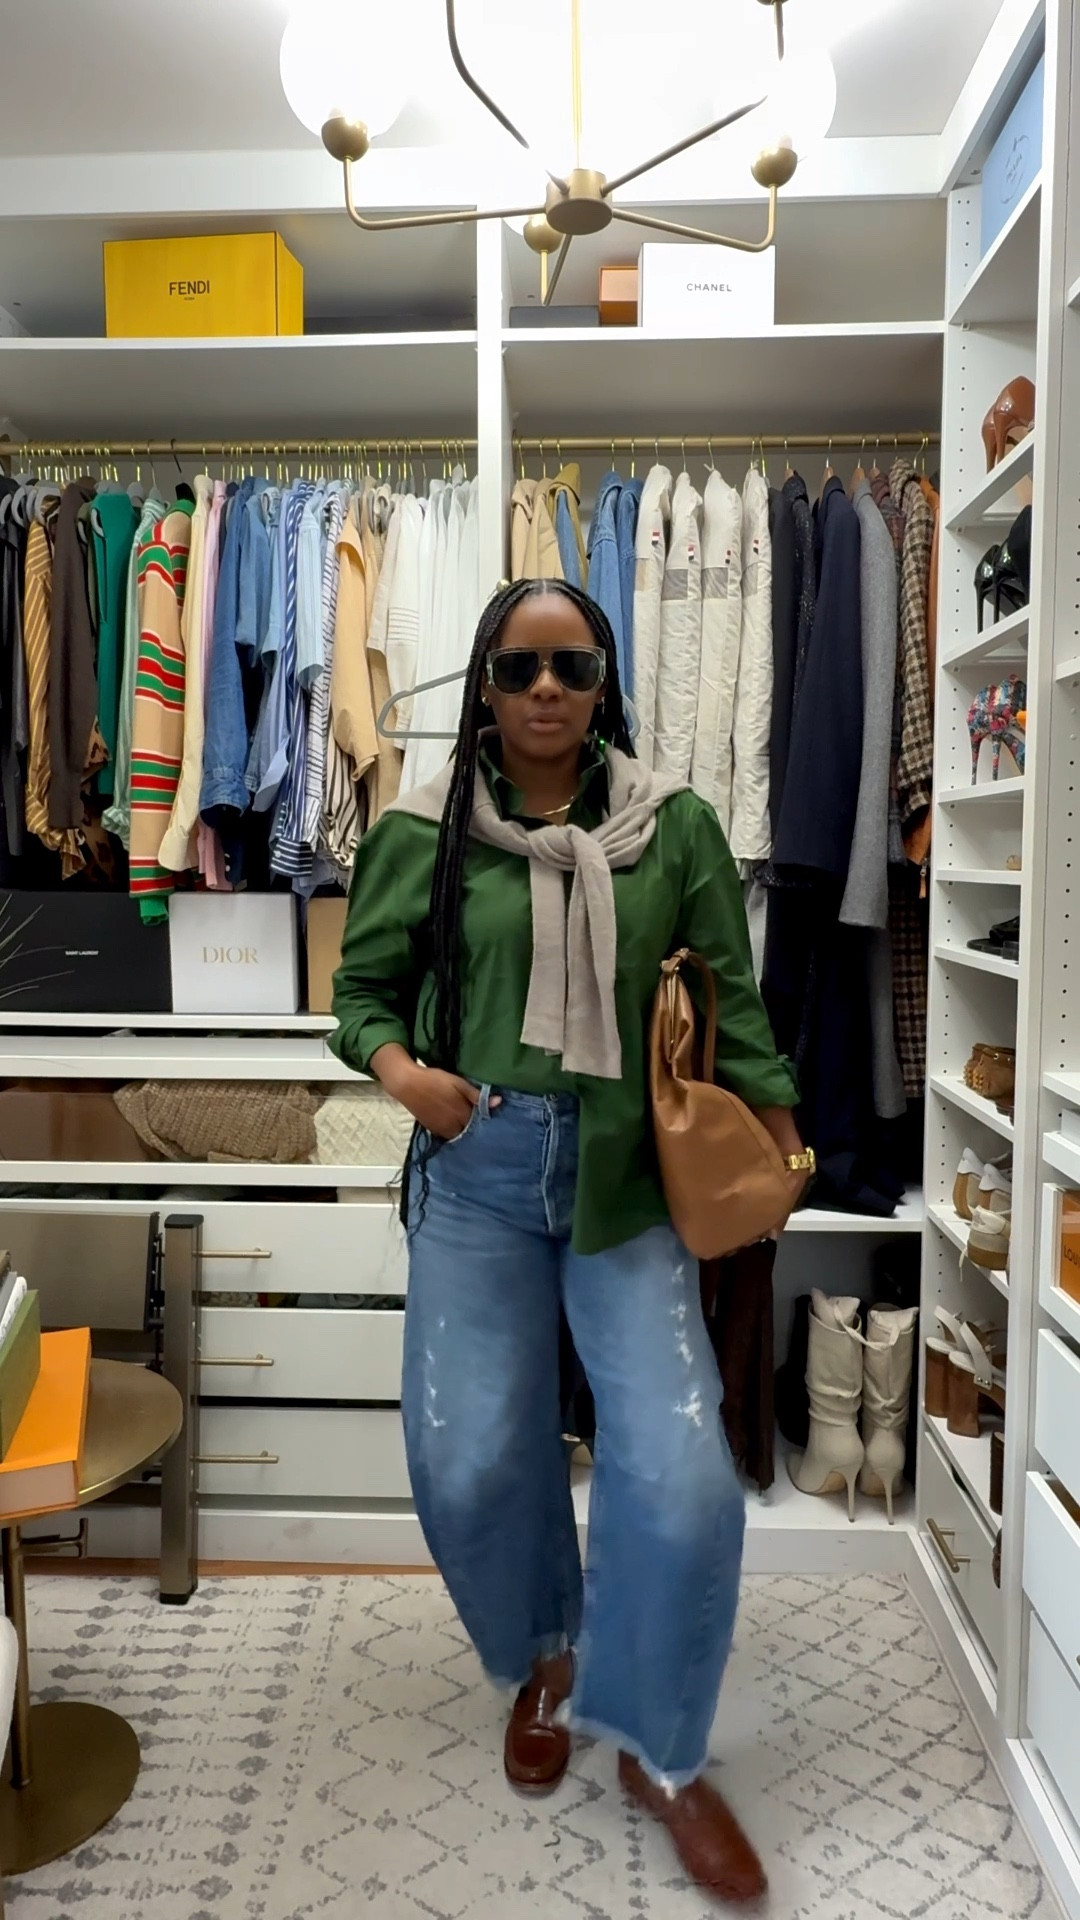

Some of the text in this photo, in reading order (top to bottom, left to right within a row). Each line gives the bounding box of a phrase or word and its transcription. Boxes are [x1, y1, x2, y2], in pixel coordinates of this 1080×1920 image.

[169, 280, 210, 296] FENDI
[686, 283, 732, 292] CHANEL
[203, 946, 259, 964] DIOR
